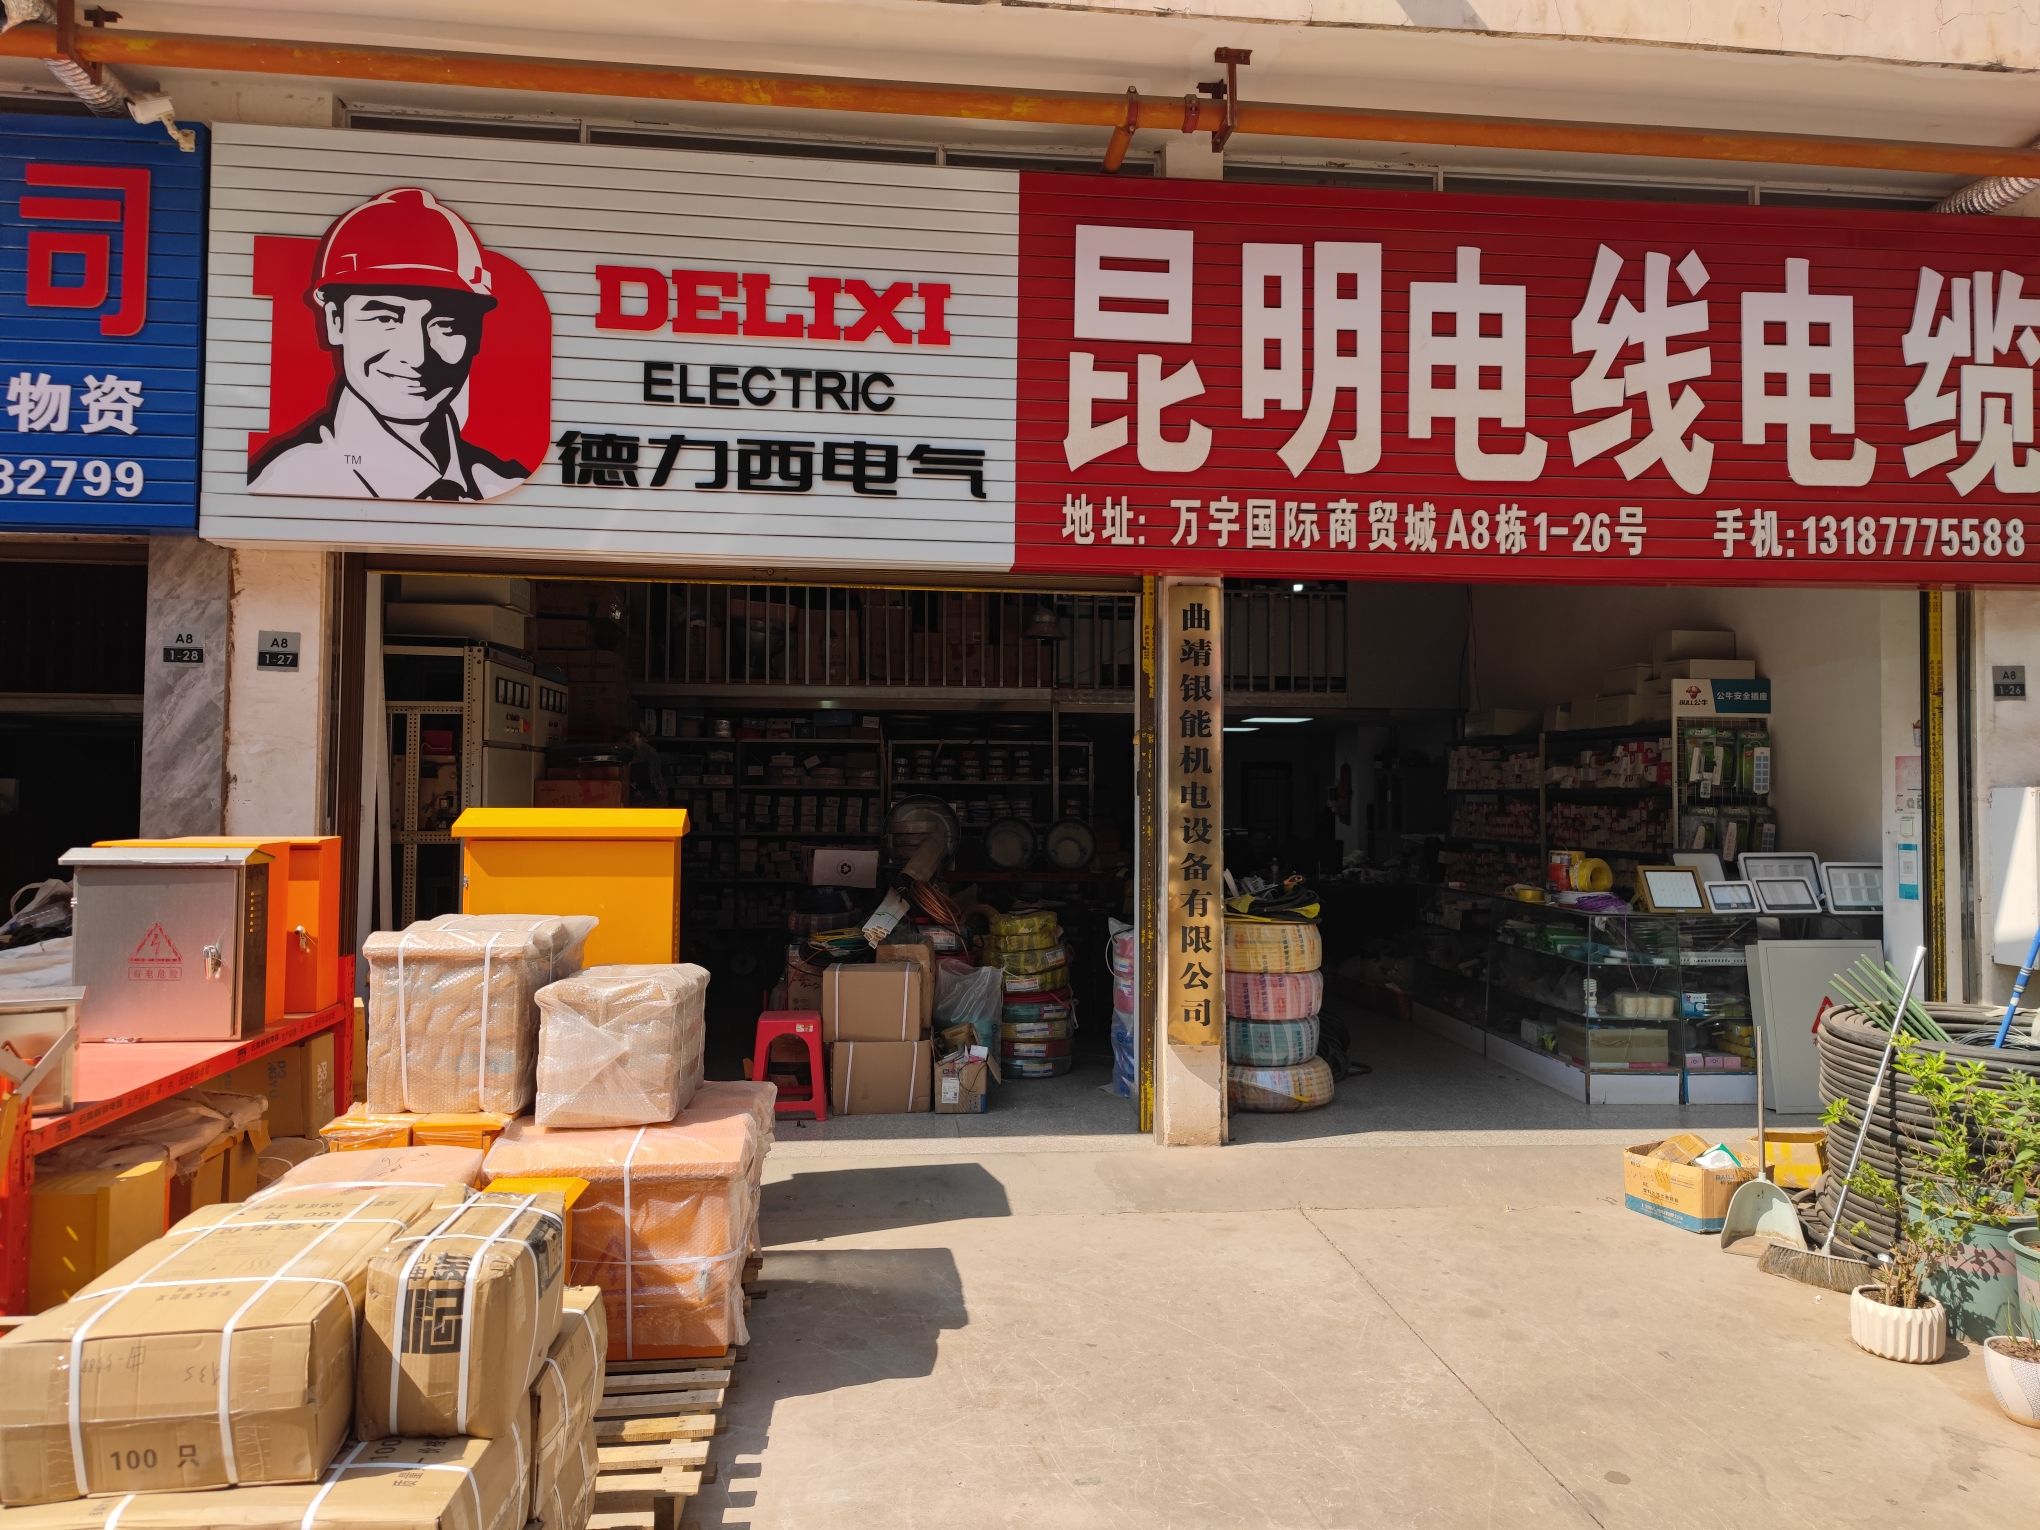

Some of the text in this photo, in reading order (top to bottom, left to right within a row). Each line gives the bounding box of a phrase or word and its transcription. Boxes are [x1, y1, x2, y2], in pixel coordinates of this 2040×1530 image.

[19, 163, 151, 337] 司
[595, 264, 951, 346] DELIXI
[1062, 223, 2040, 498] 昆明电线电缆
[6, 371, 145, 436] 物资
[643, 361, 896, 413] ELECTRIC
[556, 429, 988, 499] 德力西电气
[169, 650, 199, 661] 1-28
[175, 633, 193, 644] A8
[270, 638, 288, 648] A8
[265, 654, 293, 665] 1-27
[2002, 670, 2016, 680] A8
[1999, 685, 2021, 695] 1-26
[1178, 602, 1213, 1027] 曲靖银能机电设备有限公司
[109, 1444, 199, 1471] 100 只
